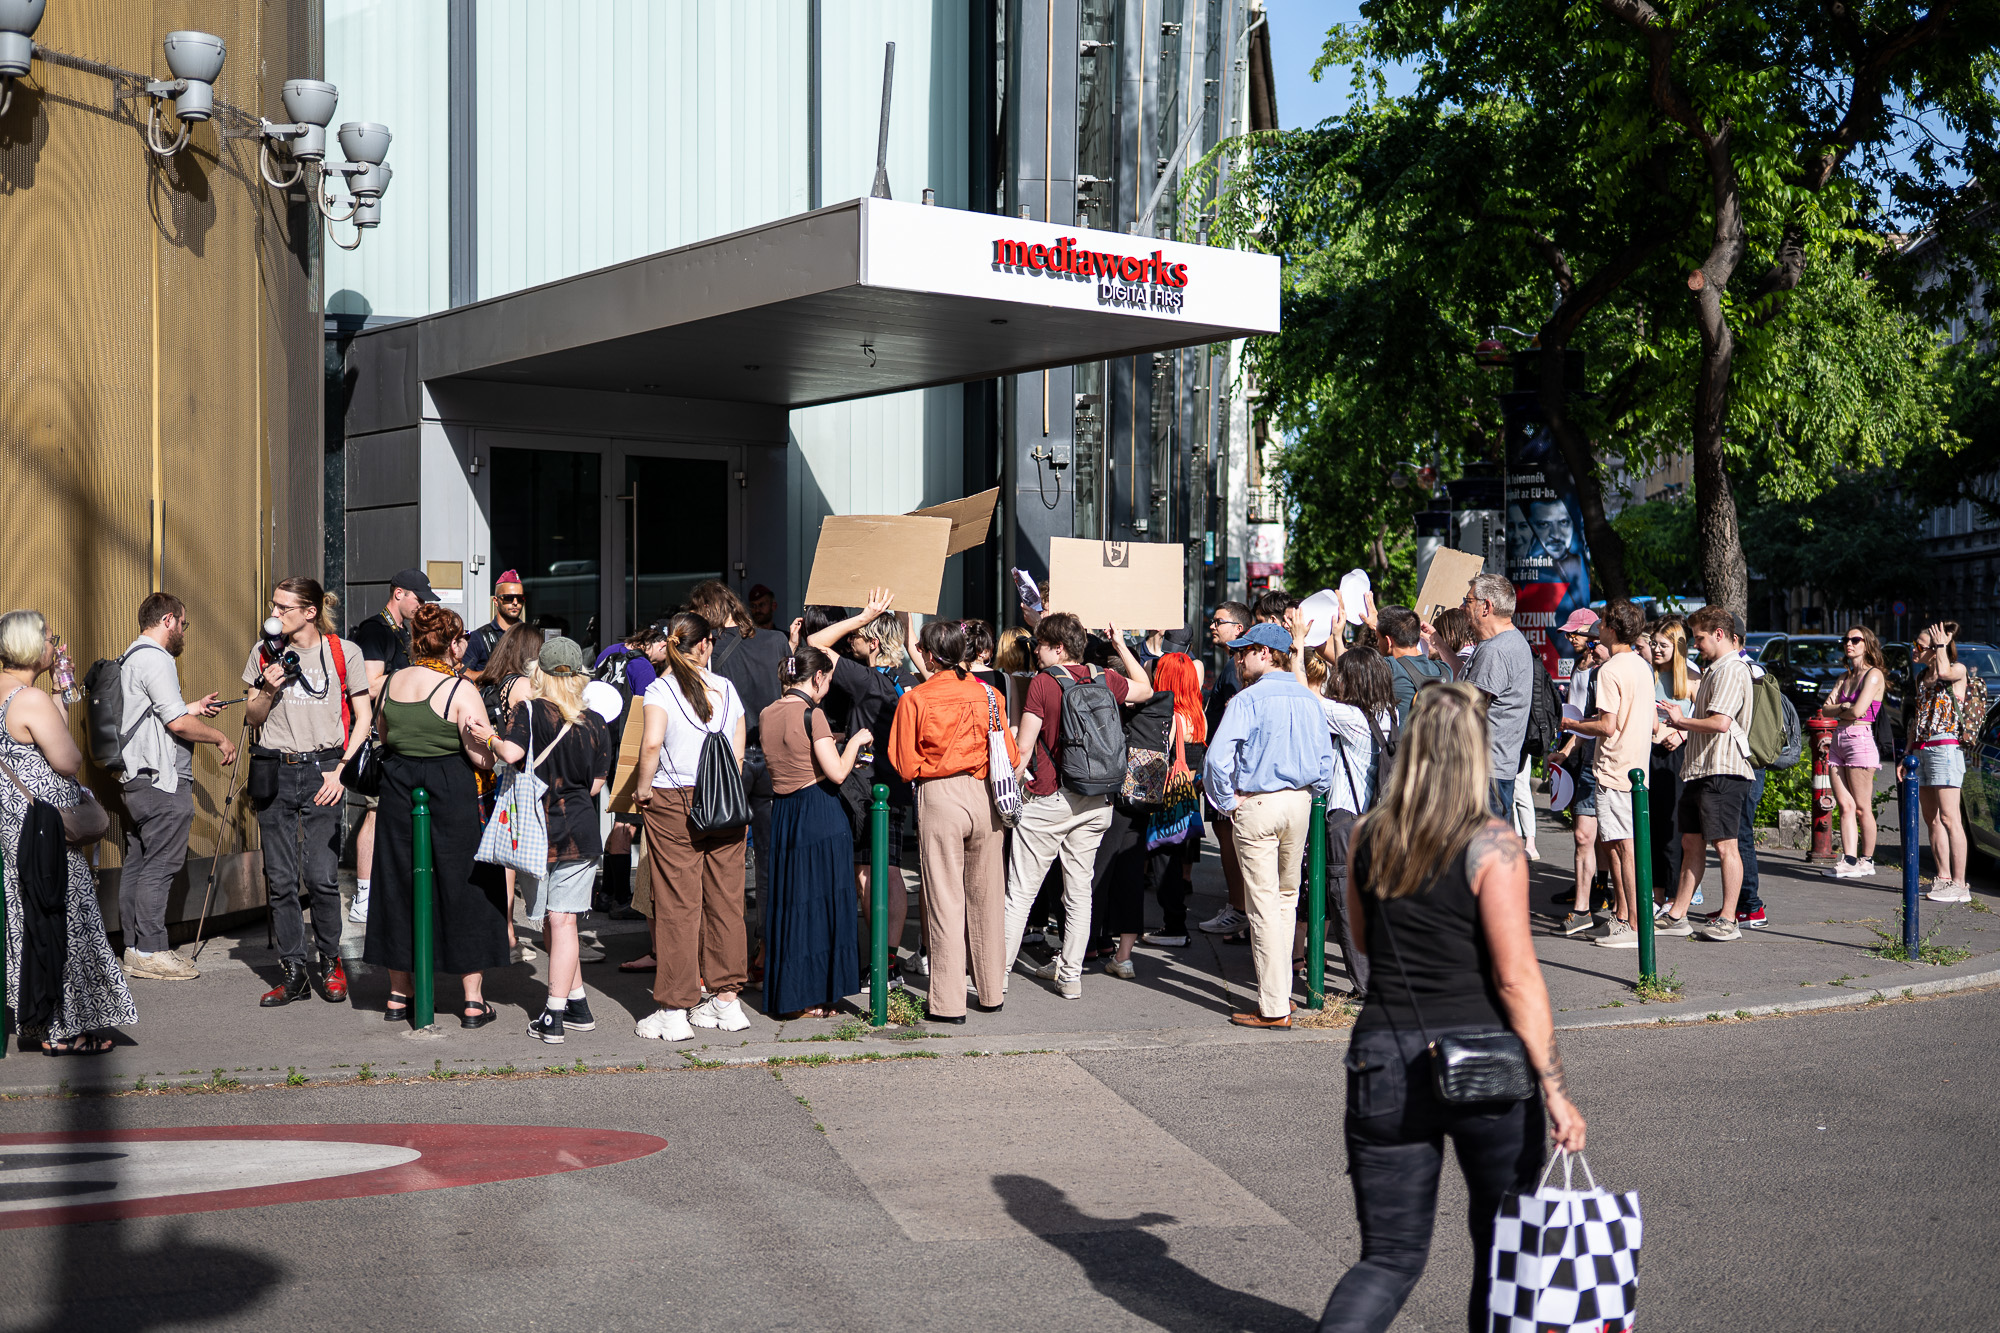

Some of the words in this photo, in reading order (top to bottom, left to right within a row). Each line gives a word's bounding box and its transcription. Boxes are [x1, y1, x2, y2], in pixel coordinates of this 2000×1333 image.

[993, 236, 1188, 288] mediaworks
[1511, 472, 1545, 484] felvennék
[1531, 487, 1558, 499] EU-ba,
[1517, 555, 1553, 567] fizetnénk
[1520, 568, 1539, 581] árát!
